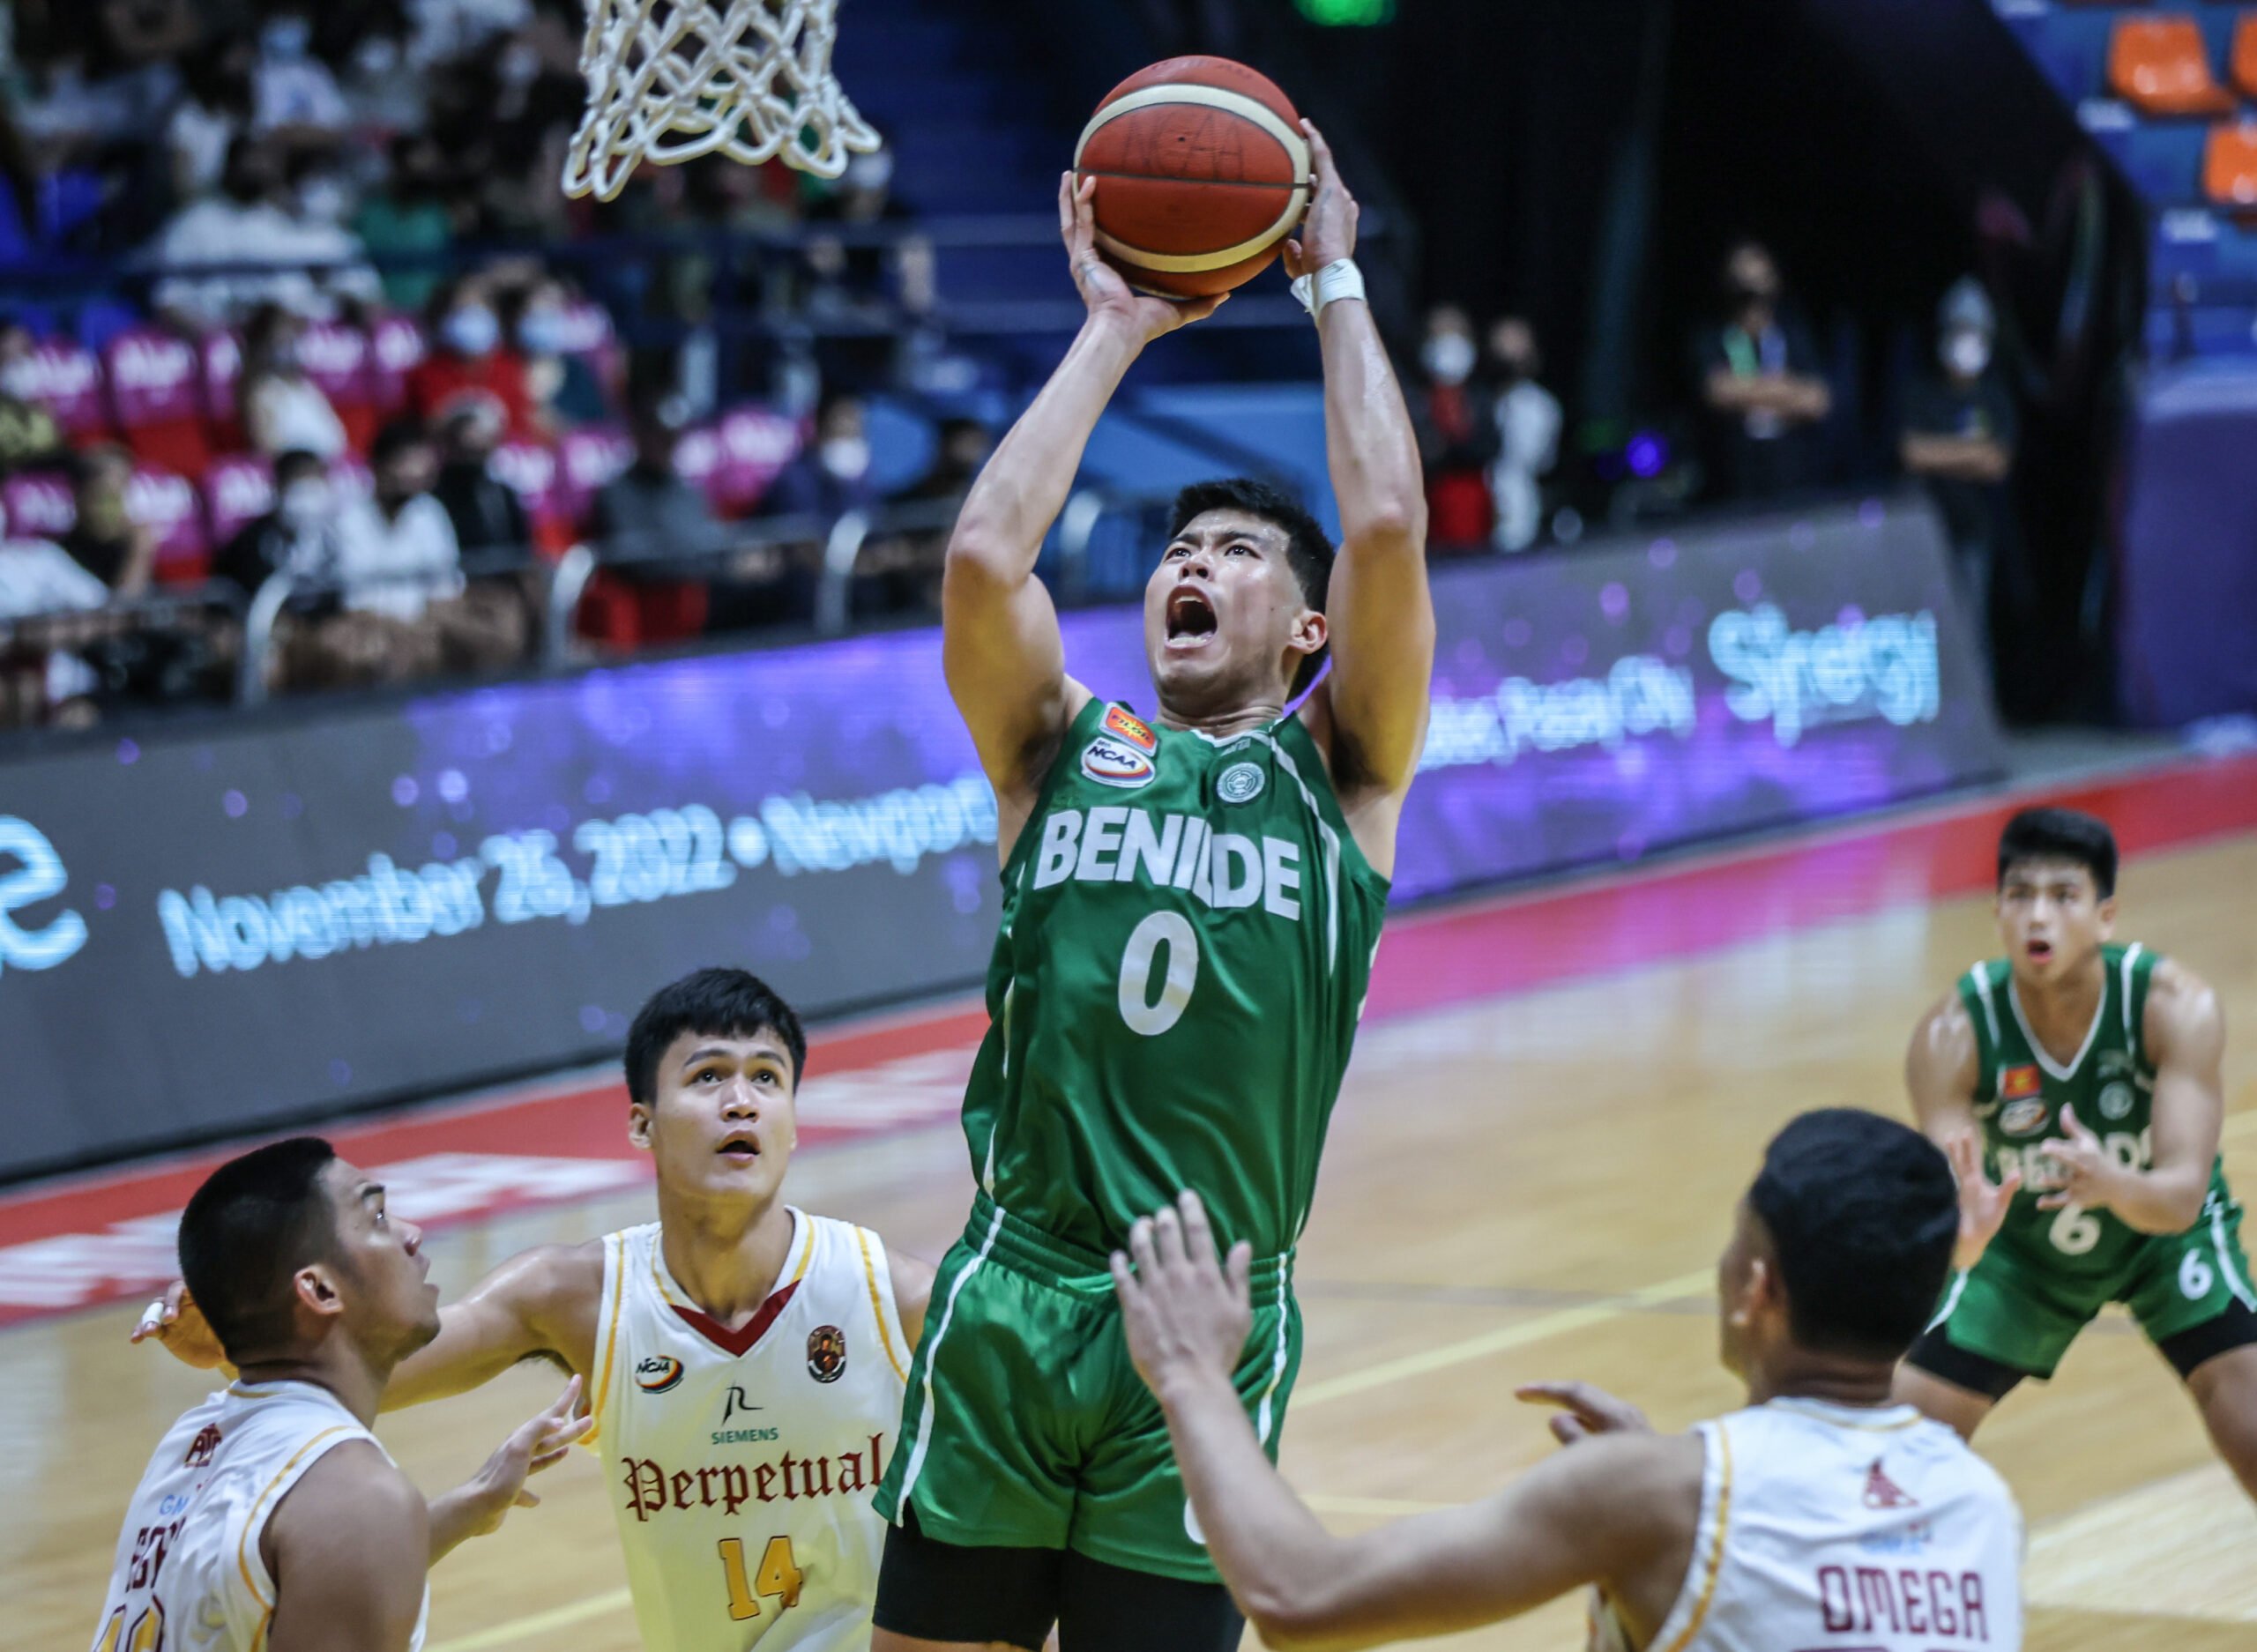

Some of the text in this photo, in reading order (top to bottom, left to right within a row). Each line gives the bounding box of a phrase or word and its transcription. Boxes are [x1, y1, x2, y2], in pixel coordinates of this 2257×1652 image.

[1087, 746, 1136, 770] NCAA
[157, 852, 484, 979] November
[1118, 911, 1199, 1037] 0
[2048, 1202, 2101, 1255] 6
[2178, 1247, 2215, 1300] 6
[635, 1361, 671, 1374] NCAA
[711, 1426, 780, 1446] SIEMENS
[621, 1432, 885, 1522] Perpetual
[718, 1535, 803, 1622] 14
[1817, 1565, 1990, 1642] OMEGA
